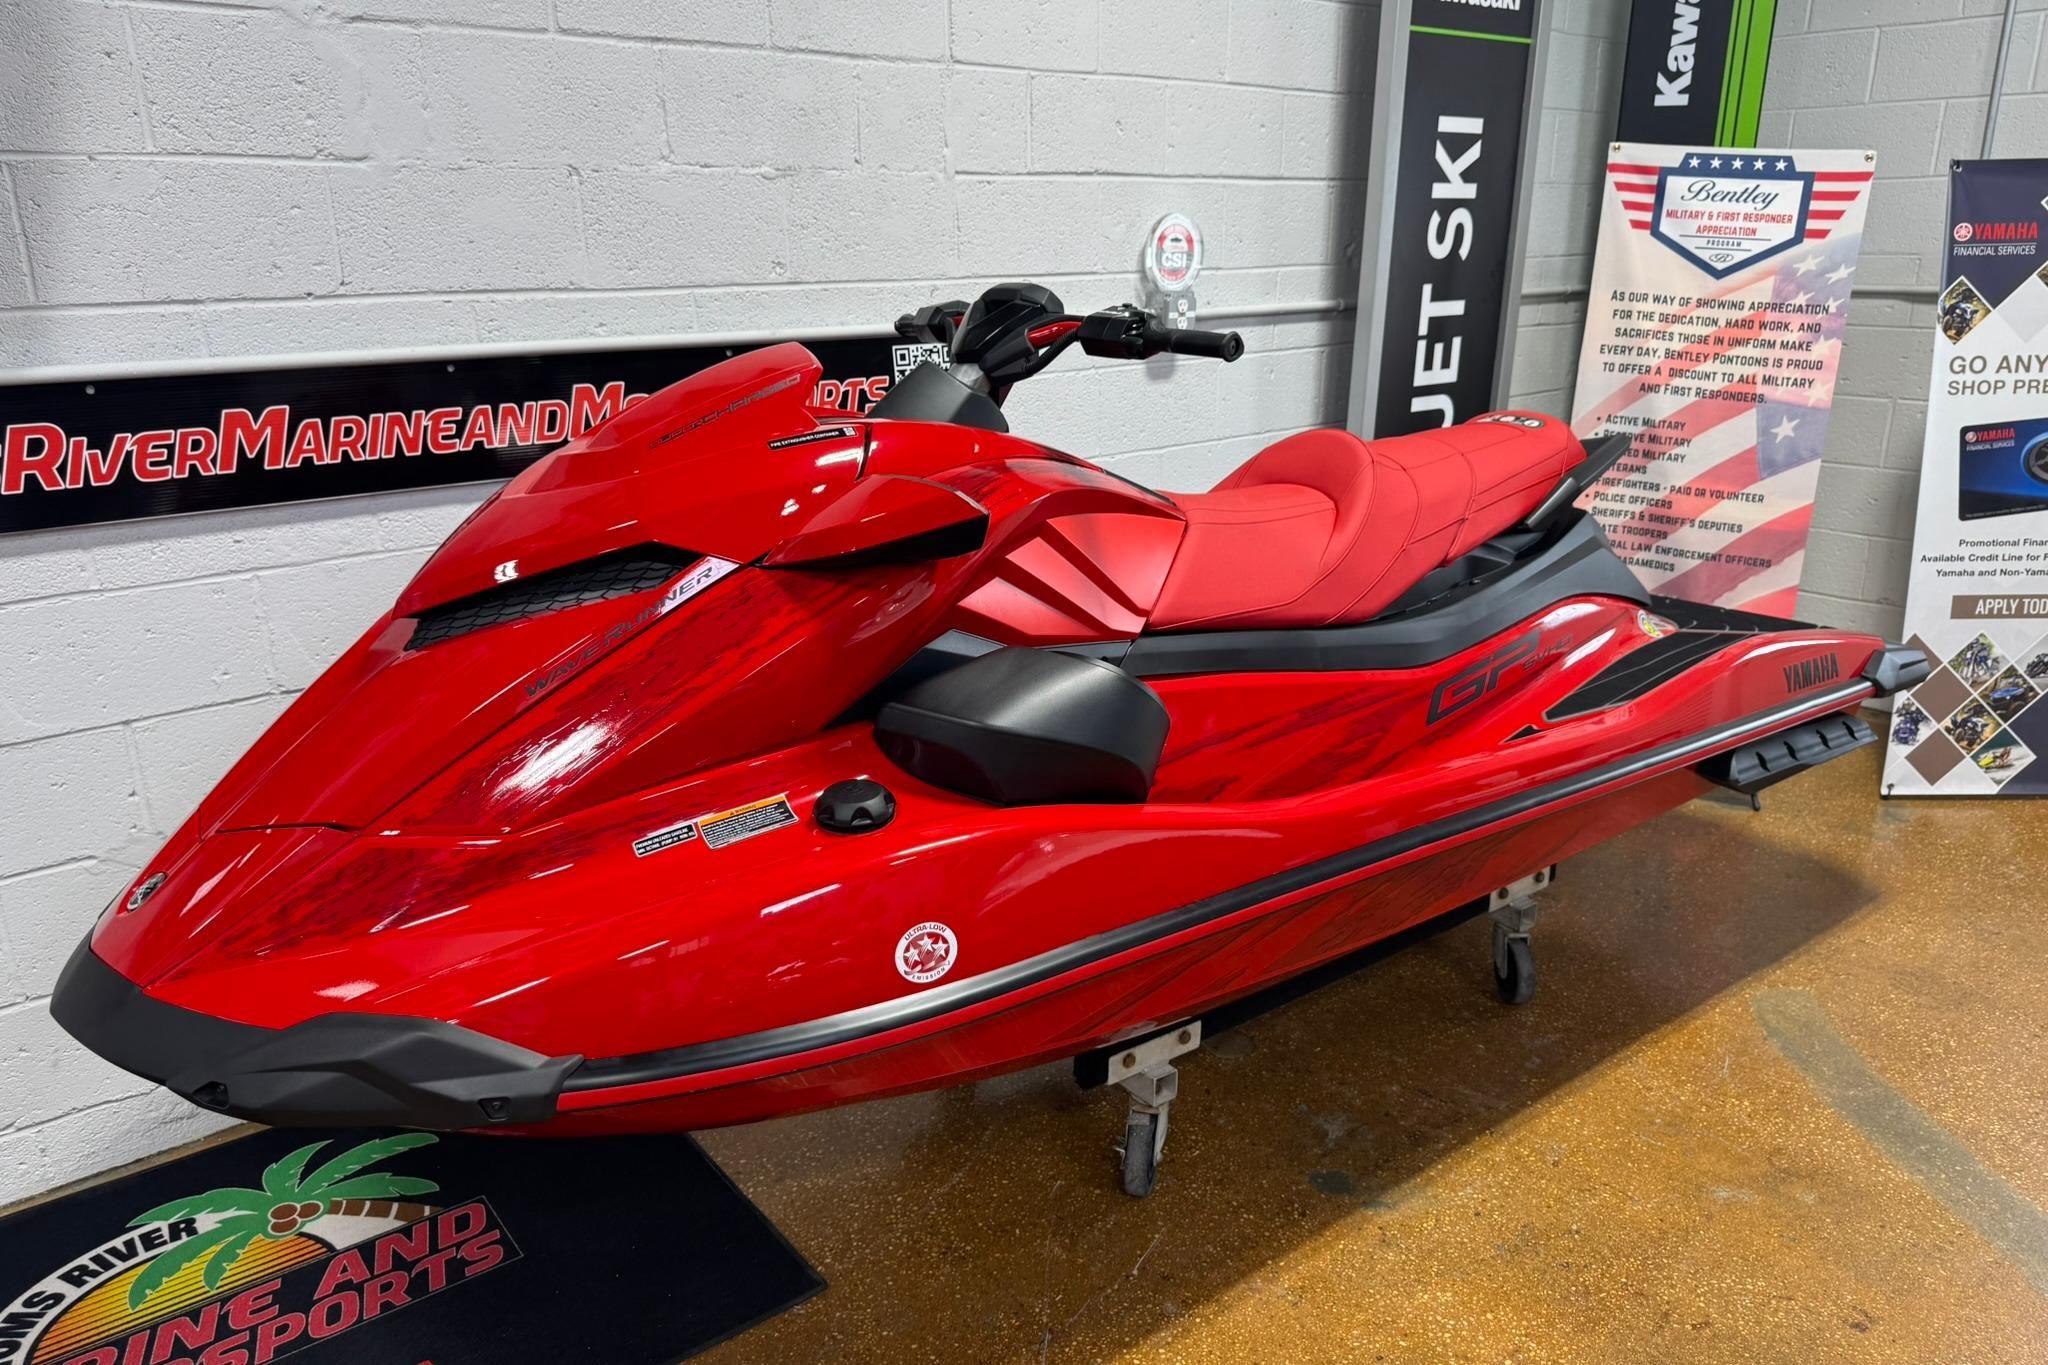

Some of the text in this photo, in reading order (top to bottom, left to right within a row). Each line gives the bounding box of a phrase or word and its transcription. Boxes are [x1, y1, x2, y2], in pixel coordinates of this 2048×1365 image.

[1654, 0, 1700, 107] Kaw
[1680, 179, 1779, 211] Bentley
[1665, 208, 1793, 224] MILITARY & FIRST RESPONDER
[1696, 225, 1757, 237] APPRECIATION
[1974, 221, 2039, 240] YAMAHA
[1706, 239, 1742, 248] PROGRAM
[1953, 245, 2036, 256] FINANCIAL SERVICES
[1161, 252, 1187, 267] CSI
[1410, 115, 1484, 428] JET SKI
[1611, 289, 1830, 316] AS OUR WAY OF SHOWING APPRECIATION
[1612, 309, 1632, 320] FOR
[1636, 310, 1656, 322] THE
[1725, 318, 1754, 330] HARD
[1758, 320, 1794, 333] WORK,
[1797, 322, 1822, 334] AND
[1614, 327, 1813, 352] SACRIFICES THOSE IN UNIFORM MAKE
[1599, 344, 1634, 355] EVERY
[1664, 348, 1710, 363] BENTLEY
[1712, 352, 1769, 368] PONTOONS
[1772, 358, 1784, 369] IS
[1786, 359, 1824, 371] PROUD
[1949, 355, 1987, 375] GO
[1603, 362, 1815, 389] TO OFFER A DISCOUNT TO ALL MILITARY
[1638, 382, 1767, 404] AND FIRST RESPONDERS.
[1947, 379, 2006, 396] SHOP
[1605, 414, 1686, 431] ACTIVE MILITARY
[1647, 434, 1692, 448] MILITARY
[1977, 428, 2016, 441] YAMAHA
[1641, 449, 1687, 463] MILITARY
[1595, 477, 1661, 491] FIREFIGHTERS
[1669, 485, 1692, 496] PAID
[1694, 488, 1707, 497] OR
[1709, 489, 1765, 504] VOLUNTEER
[1593, 491, 1673, 510] POLICE OFFICERS
[1591, 506, 1743, 534] SHERIFFS & SHERIFF'S DEPUTIES
[1621, 525, 1668, 540] TROOPERS
[1959, 538, 2020, 547] Promotional
[1620, 556, 1676, 572] ARAMEDICS
[1630, 541, 1653, 553] LAW
[1655, 545, 1725, 563] ENFORCEMENT
[1724, 554, 1772, 569] OFFICERS
[1920, 554, 1965, 563] Available
[1968, 553, 1999, 562] Credit
[2002, 553, 2023, 562] Line
[2026, 553, 2041, 561] for
[1936, 569, 1975, 577] Yamaha
[1978, 568, 1997, 577] and
[1975, 598, 2019, 615] APPLY
[524, 566, 713, 697] WAVERUNNER
[1426, 627, 1542, 727] GP
[1783, 652, 1840, 694] YAMAHA
[912, 967, 945, 980] EMISSION
[56, 1217, 199, 1289] RIVER
[313, 1202, 486, 1300] AND
